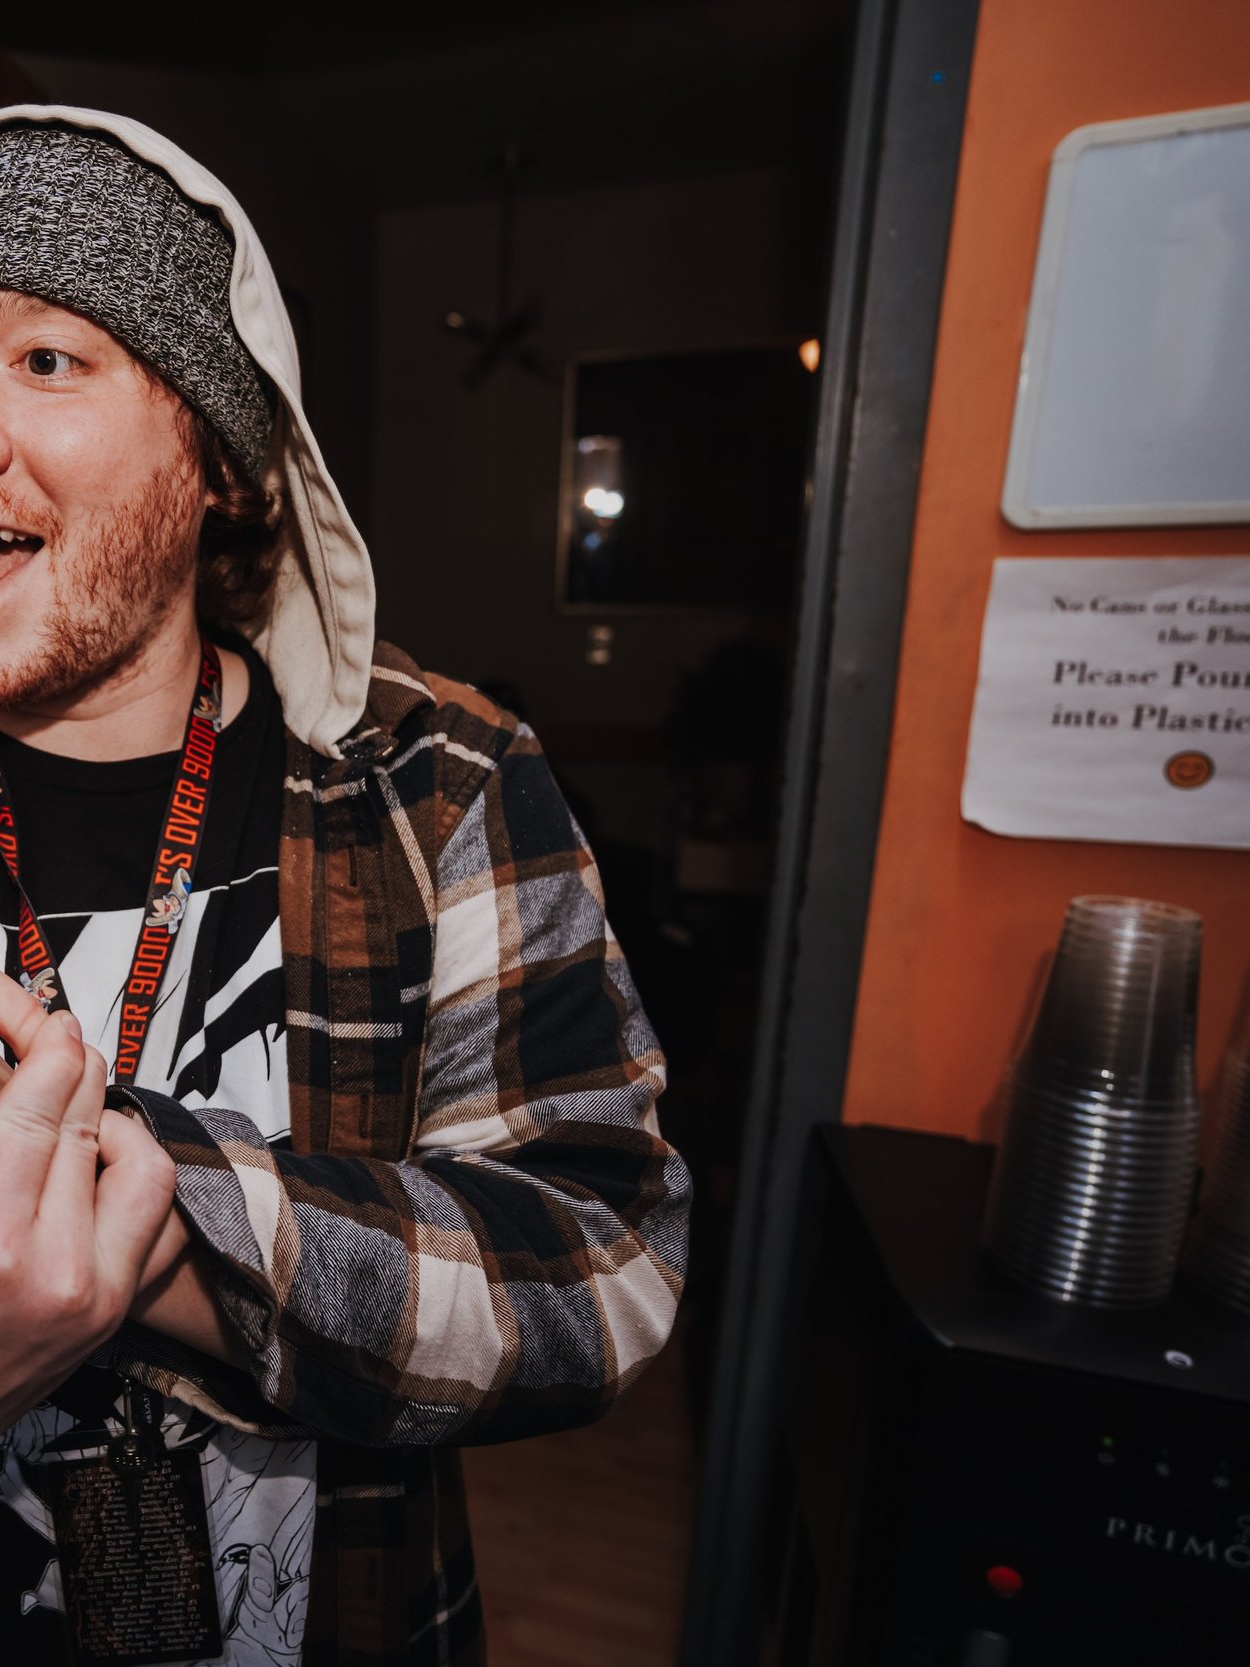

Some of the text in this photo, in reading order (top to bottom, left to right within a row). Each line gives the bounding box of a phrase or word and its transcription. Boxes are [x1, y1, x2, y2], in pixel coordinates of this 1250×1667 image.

[1053, 661, 1158, 686] Please
[1052, 703, 1118, 727] into
[163, 777, 207, 847] OVER
[116, 1002, 151, 1076] OVER
